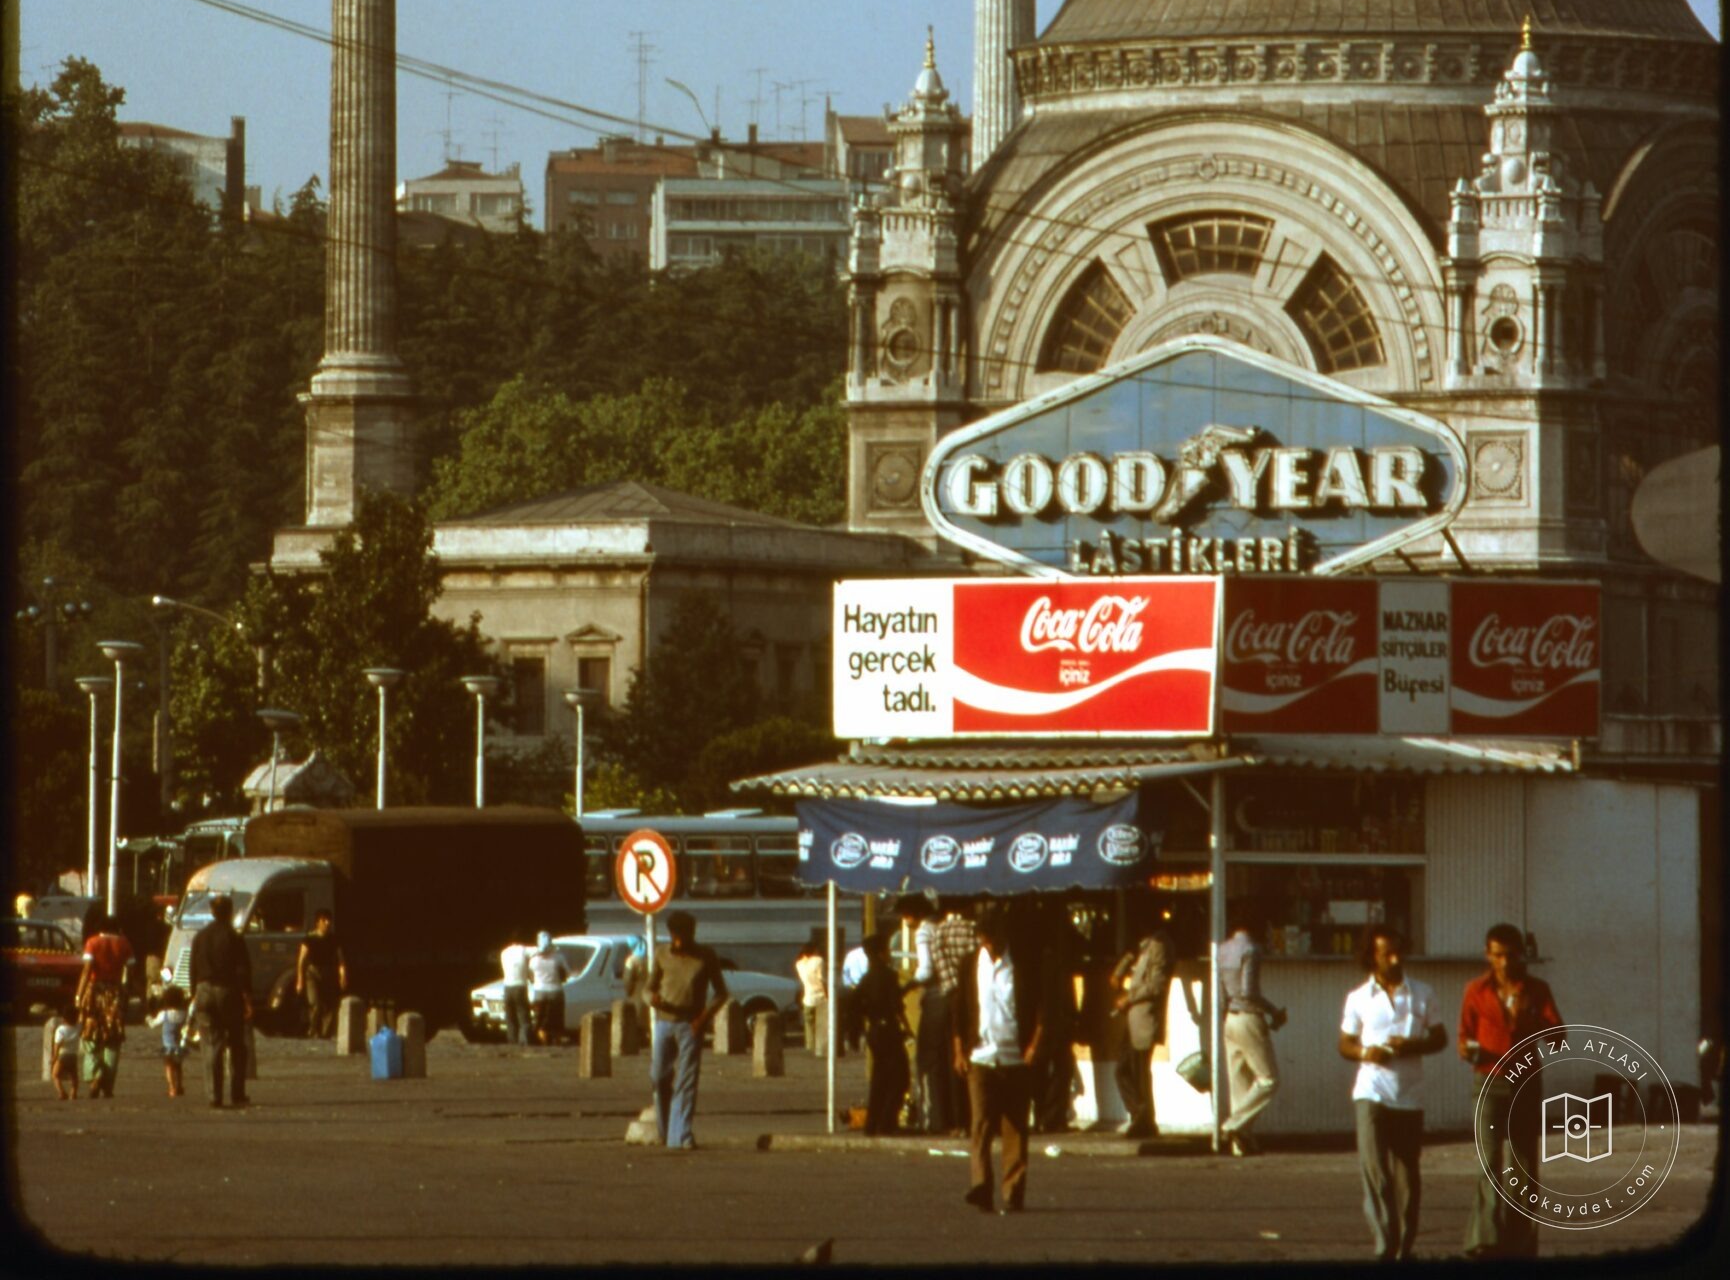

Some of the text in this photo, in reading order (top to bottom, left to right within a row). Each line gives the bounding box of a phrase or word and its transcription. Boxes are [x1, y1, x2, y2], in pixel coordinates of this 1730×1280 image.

[843, 604, 938, 639] Hayatın
[1020, 595, 1150, 653] Coca-Cola
[1224, 608, 1359, 665] Coca-Cola
[1383, 610, 1447, 632] MAZHAR
[1382, 635, 1447, 661] SÜTÇÜLER
[1468, 612, 1596, 669] Coca-Cola
[849, 644, 936, 679] gerçek
[882, 683, 936, 712] tadı.
